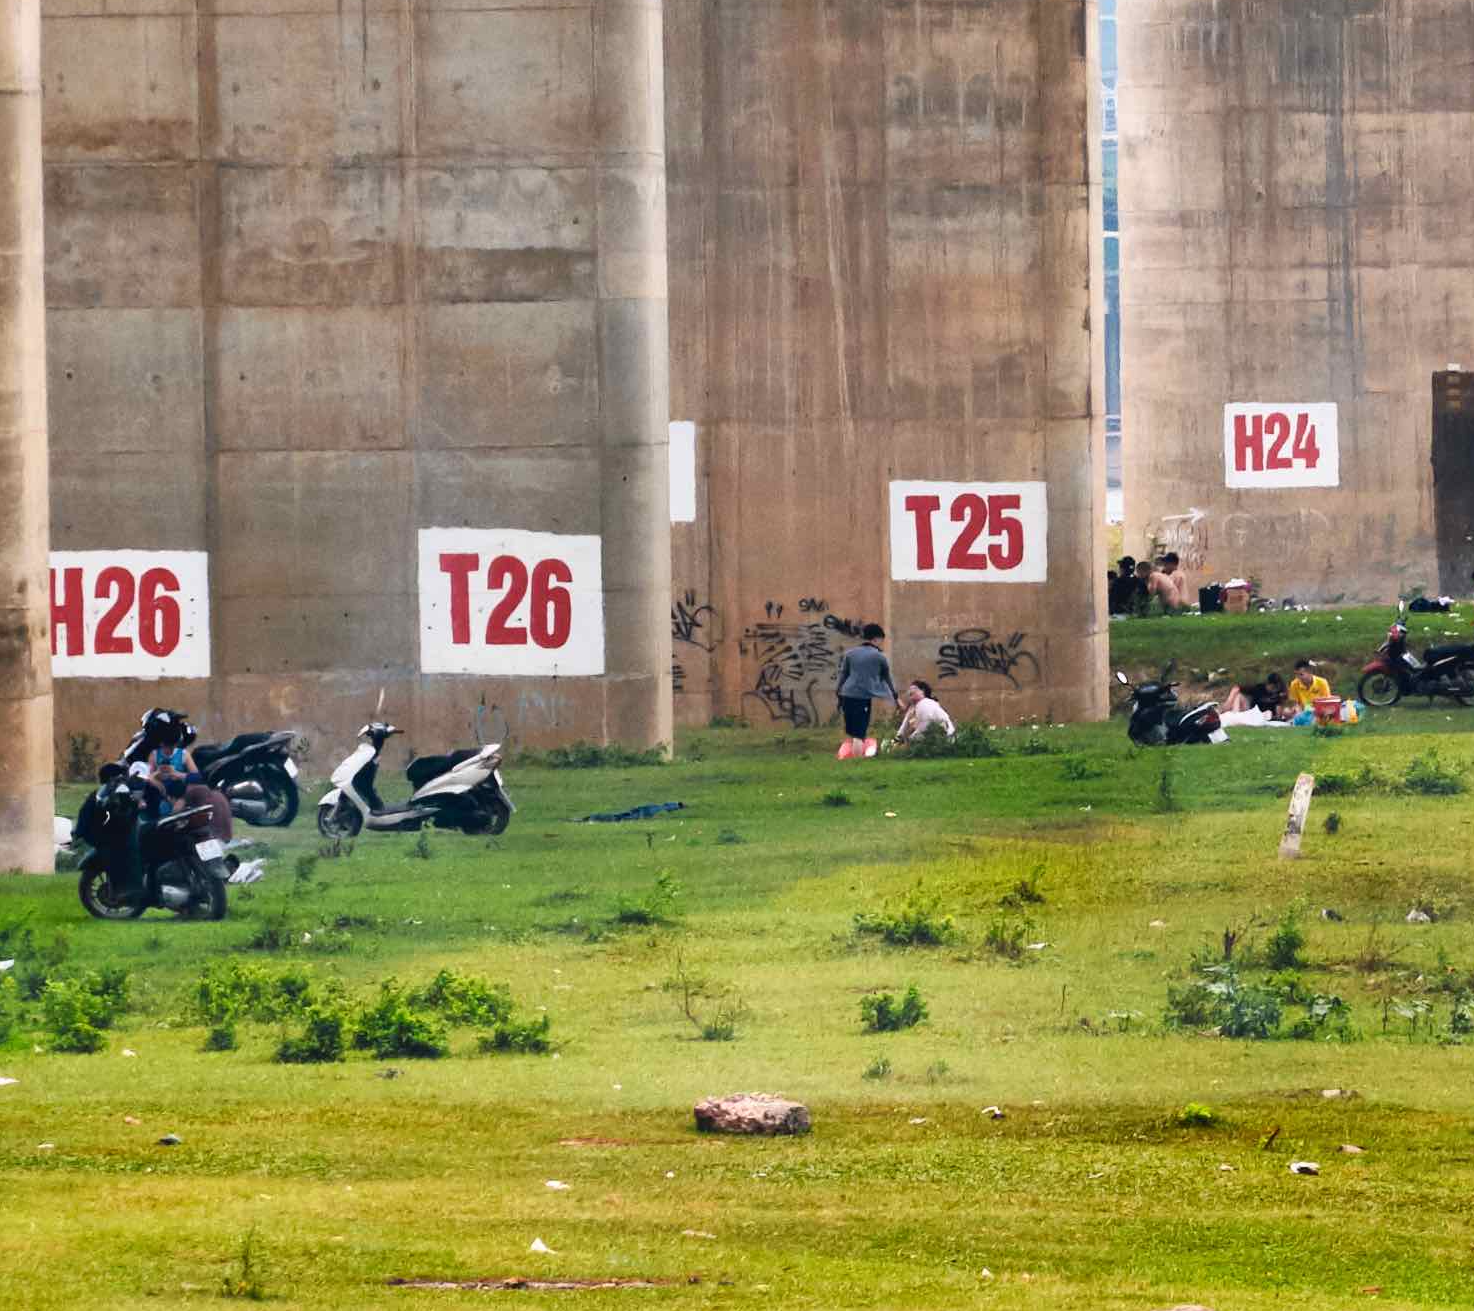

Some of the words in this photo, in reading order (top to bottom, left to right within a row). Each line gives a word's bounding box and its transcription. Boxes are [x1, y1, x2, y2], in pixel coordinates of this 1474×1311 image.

[1233, 412, 1321, 473] H24
[903, 493, 1025, 572] T25
[49, 566, 181, 658] H26
[439, 553, 574, 649] T26
